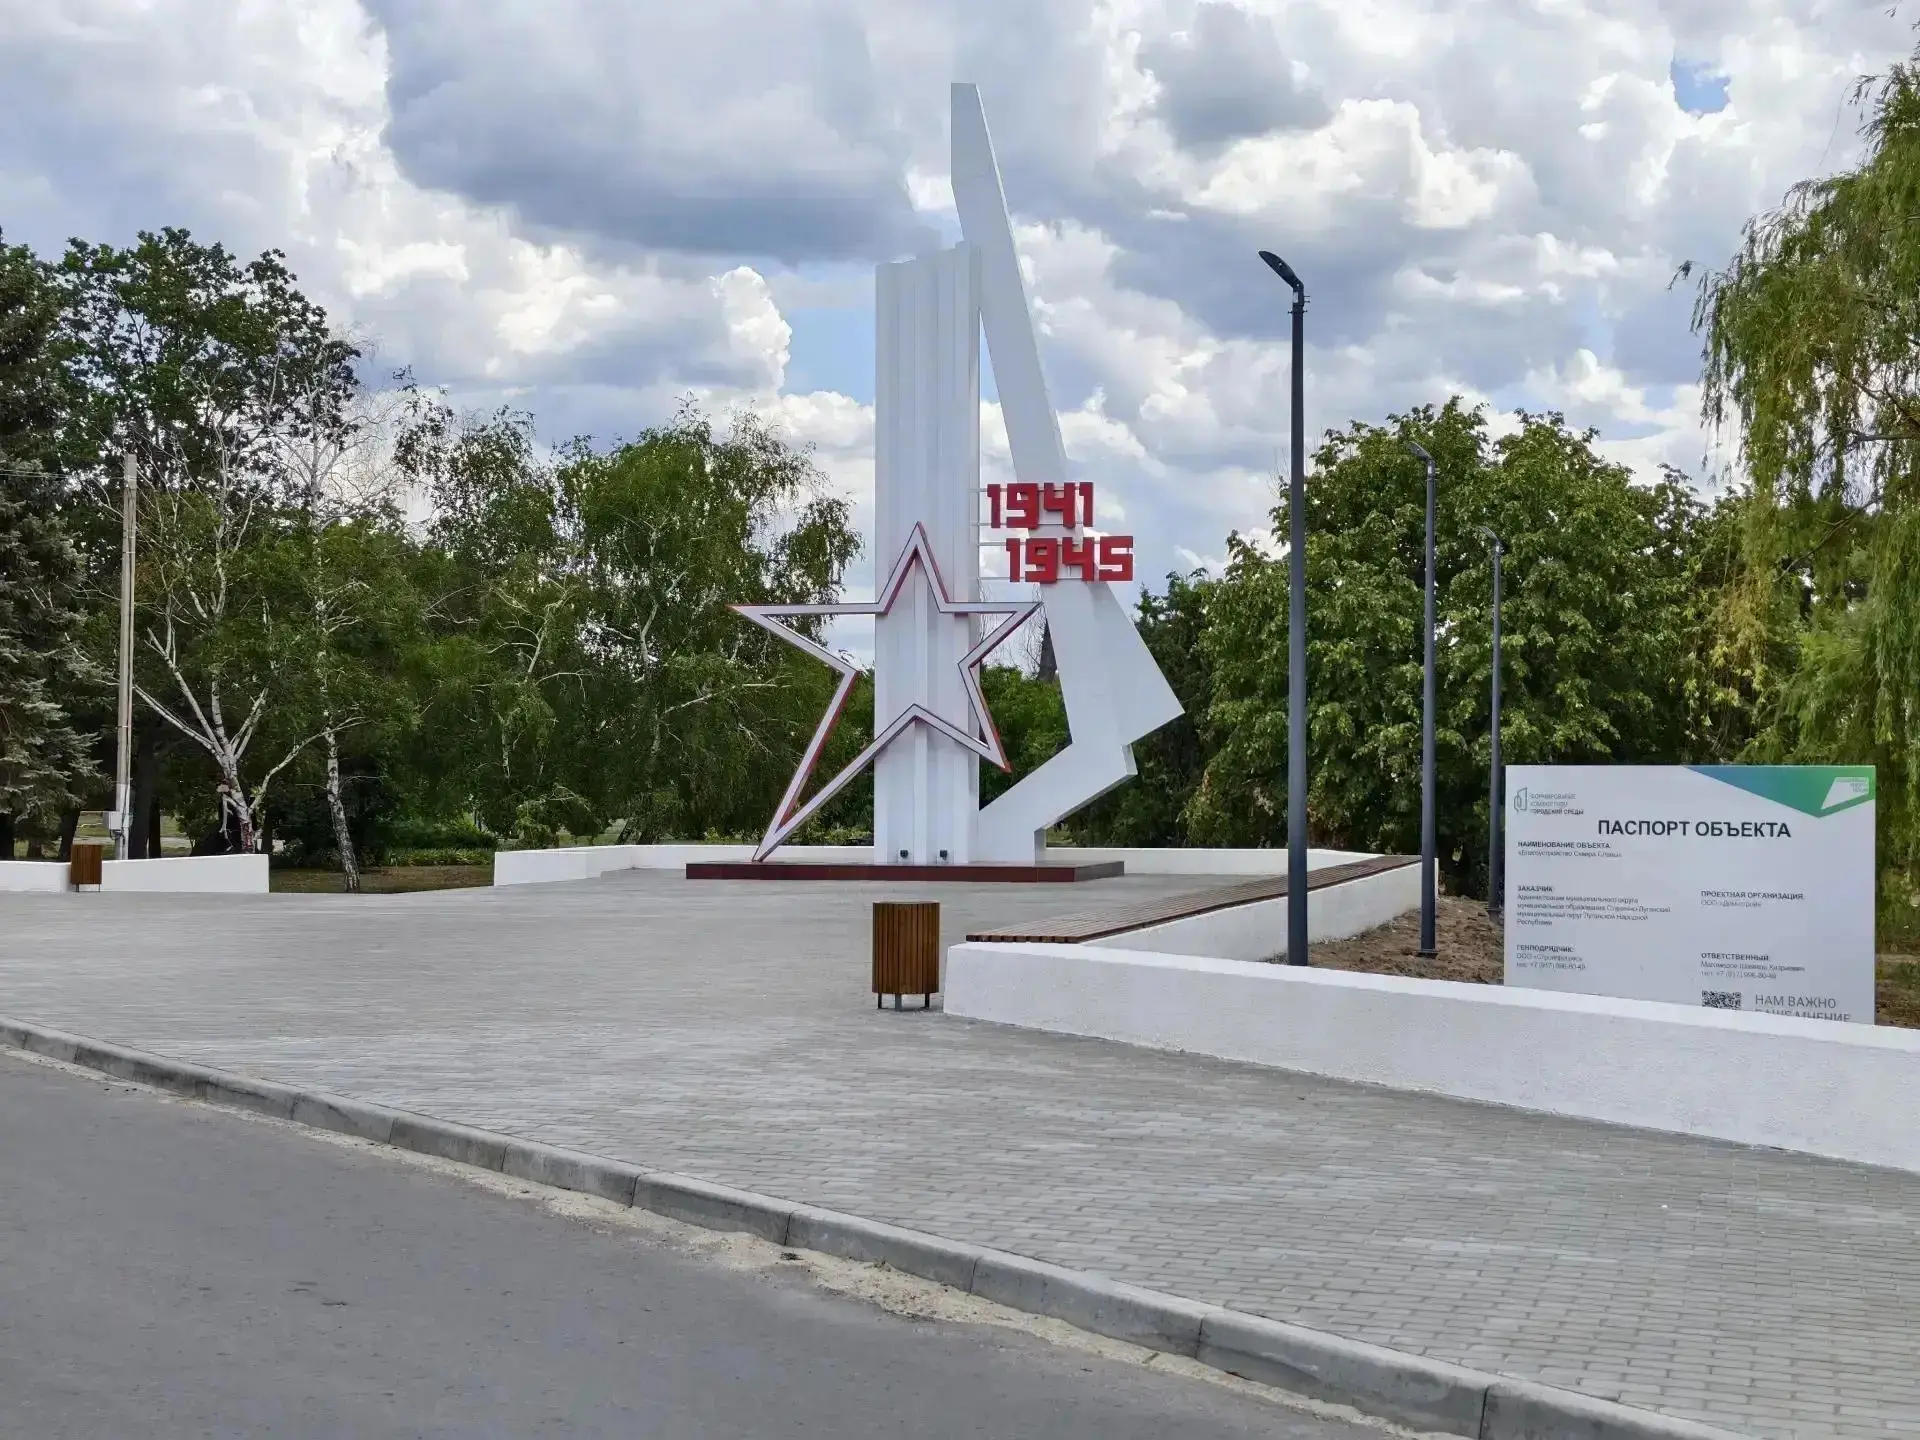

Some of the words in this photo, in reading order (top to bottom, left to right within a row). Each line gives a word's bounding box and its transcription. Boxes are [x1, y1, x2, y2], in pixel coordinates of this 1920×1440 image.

[987, 482, 1093, 529] 1941
[1006, 536, 1133, 583] 1945
[1598, 820, 1690, 836] ПАСПОРТ
[1695, 821, 1792, 838] ОБЪЕКТА
[1518, 841, 1575, 849] НАИМЕНОВАНИЕ
[1755, 994, 1784, 1006] НАМ
[1787, 996, 1836, 1009] ВАЖНО
